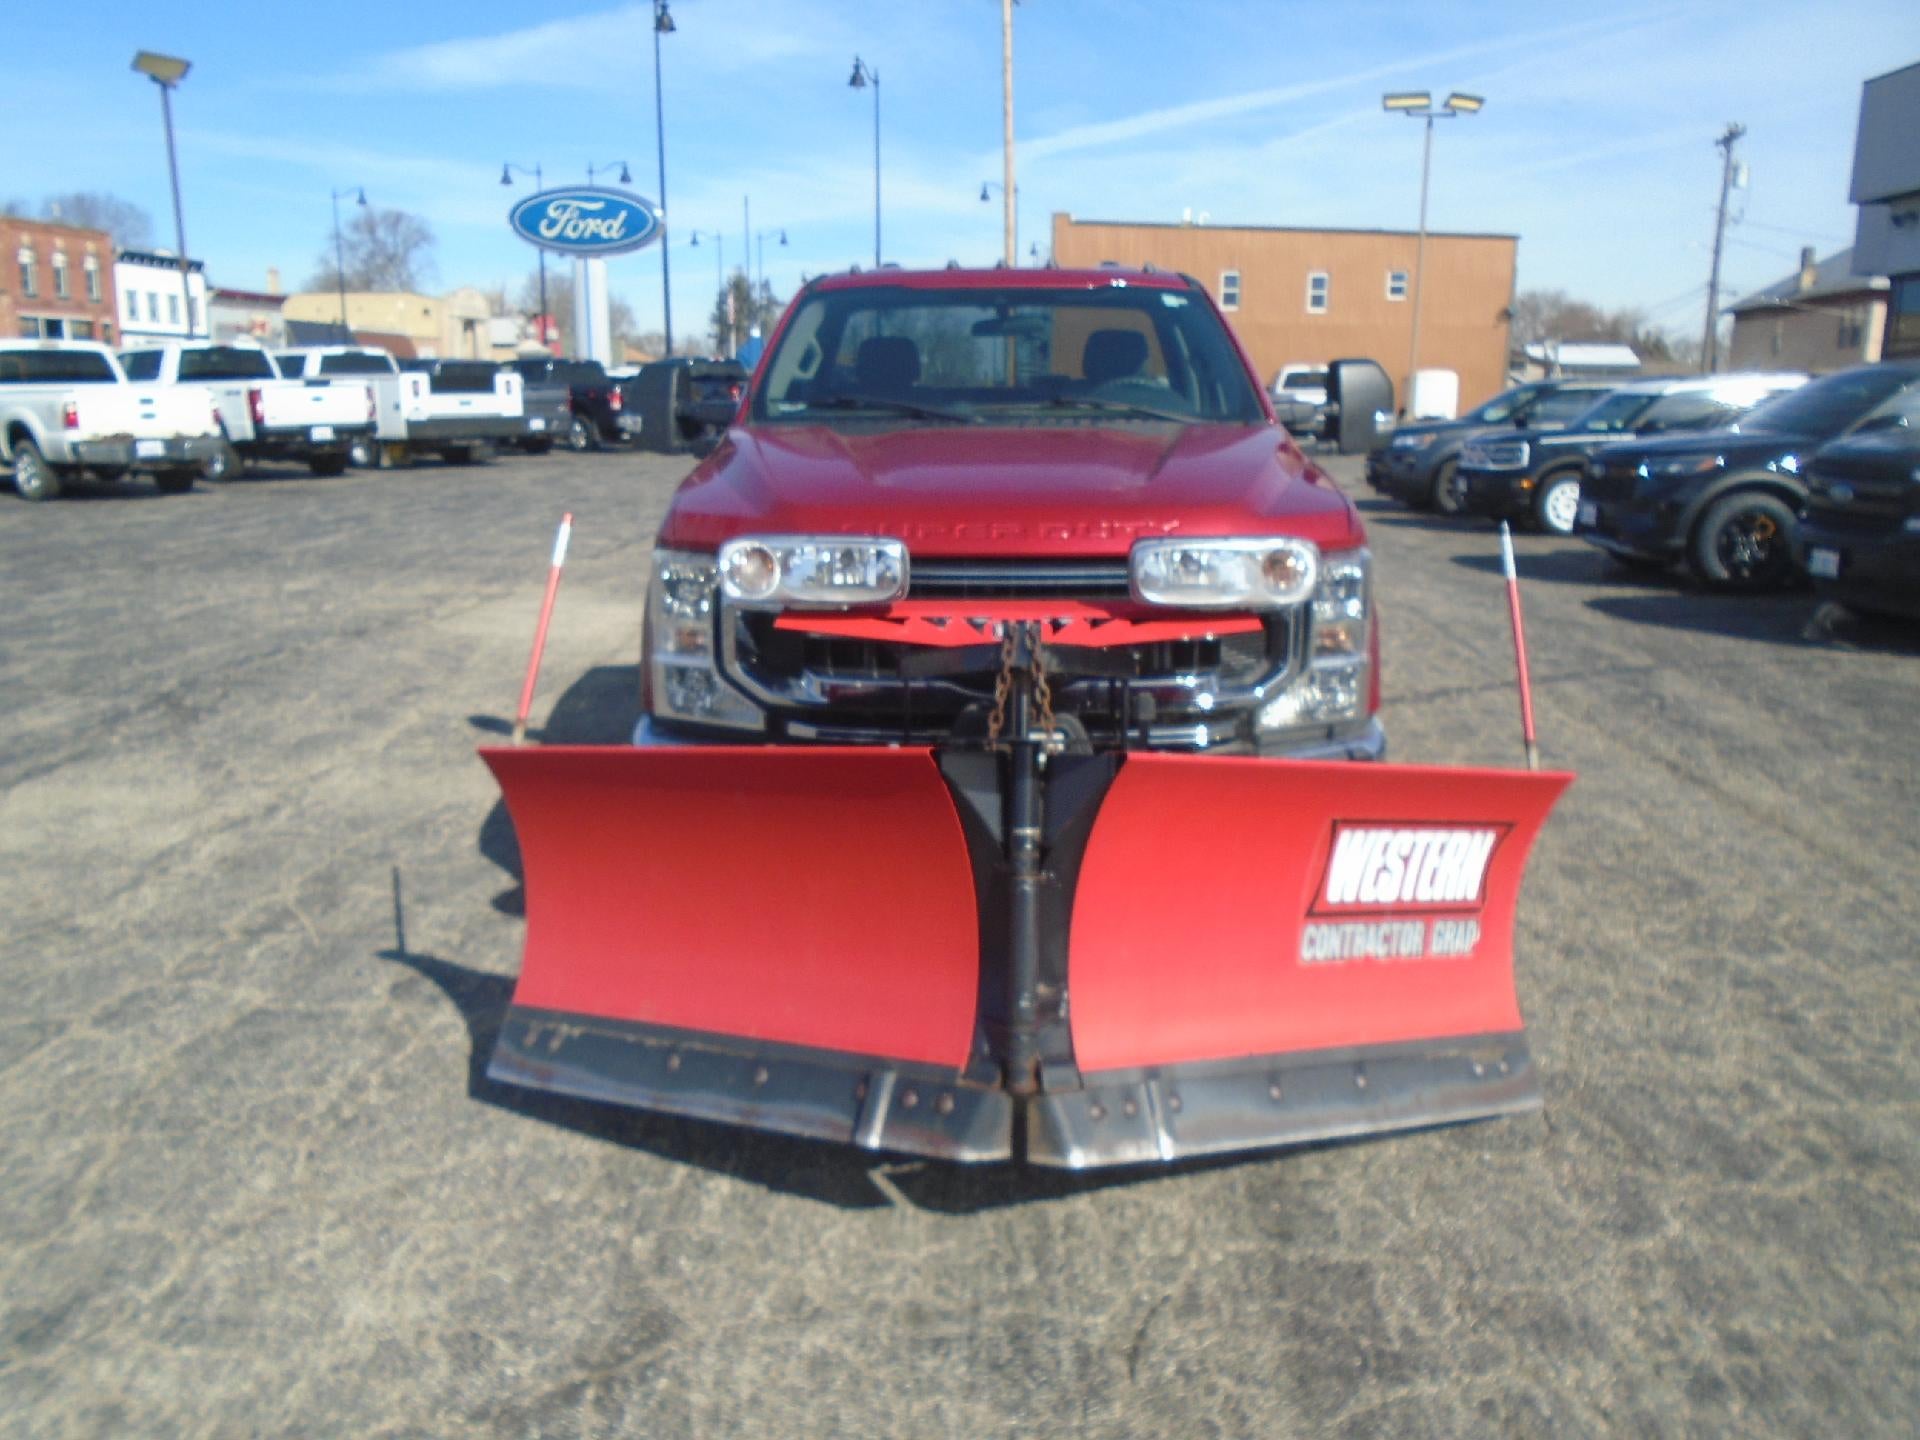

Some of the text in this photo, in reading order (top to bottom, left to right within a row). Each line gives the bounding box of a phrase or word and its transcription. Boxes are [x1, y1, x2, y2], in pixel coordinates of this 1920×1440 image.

[540, 199, 627, 240] Ford
[1326, 829, 1497, 904] WESTERN
[1301, 921, 1424, 961] CONTRACTOR
